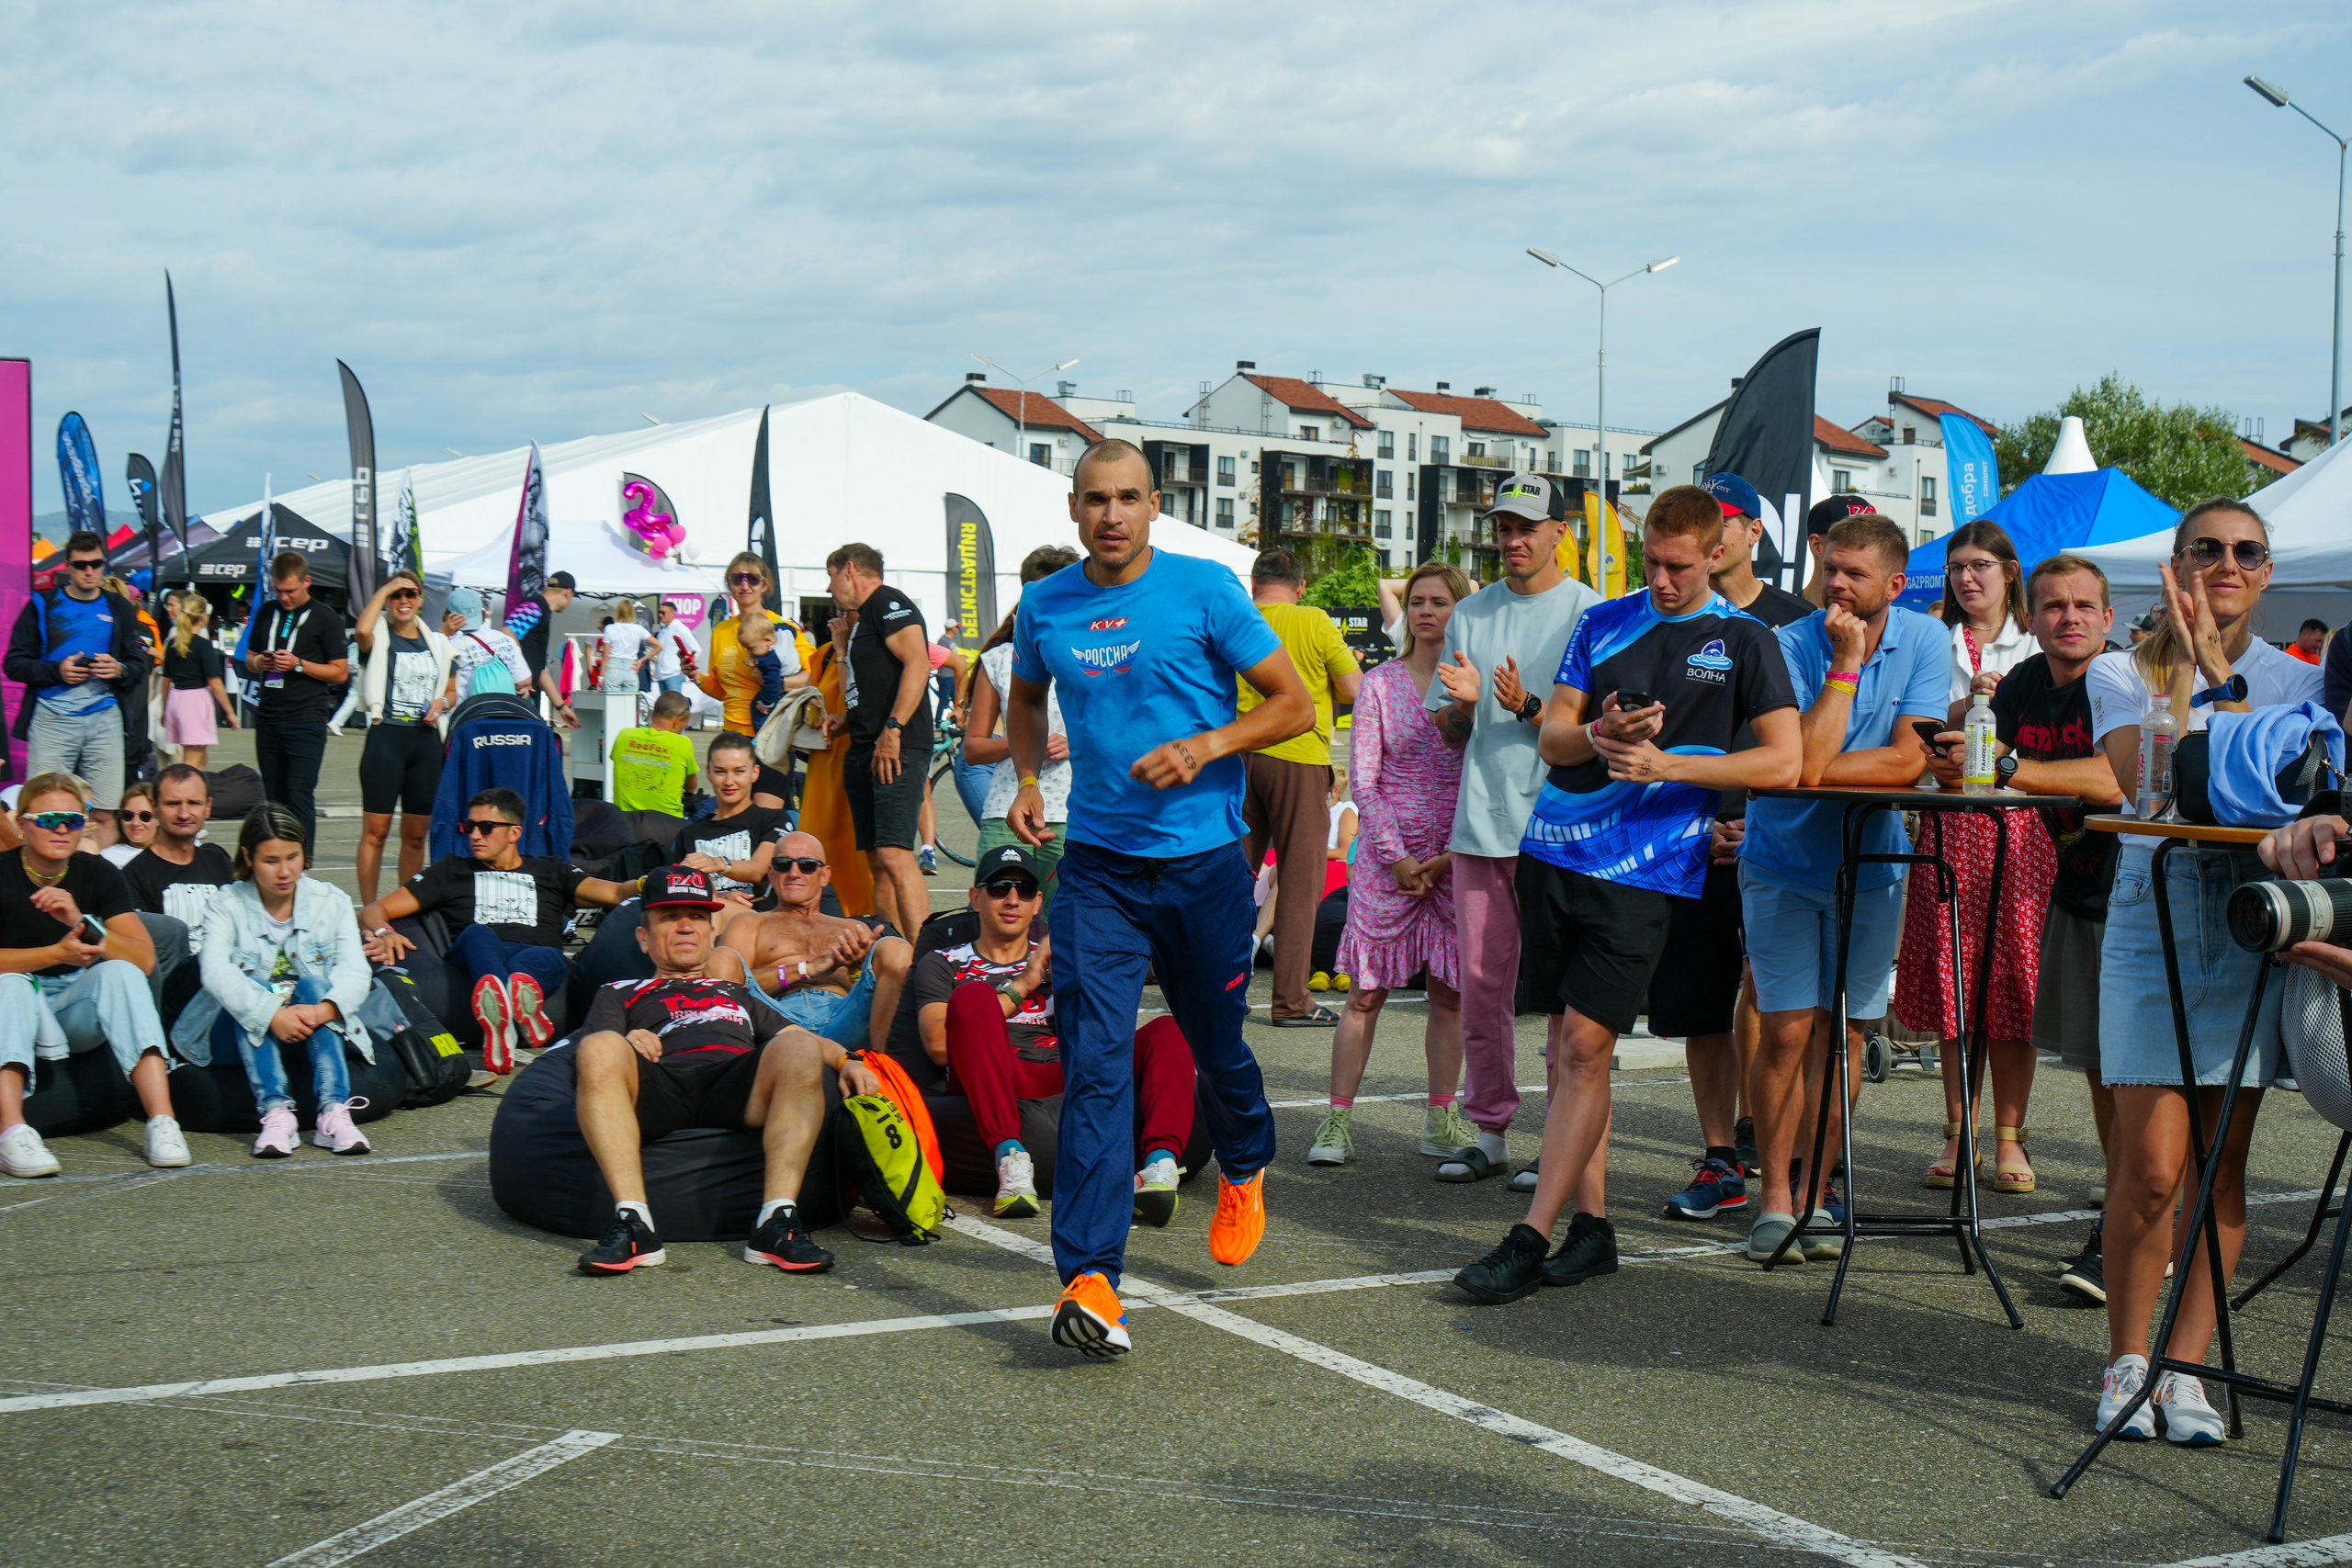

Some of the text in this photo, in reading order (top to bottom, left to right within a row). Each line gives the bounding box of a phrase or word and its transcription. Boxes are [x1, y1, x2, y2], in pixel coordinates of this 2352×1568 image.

[1521, 484, 1541, 496] STAR
[1962, 462, 1977, 516] добра
[275, 536, 329, 552] cep
[214, 564, 247, 578] cep
[666, 598, 702, 615] HOP
[1348, 617, 1368, 628] STAR
[1085, 645, 1128, 668] РОССИЯ
[1687, 668, 1725, 682] ВОЛНА
[472, 734, 532, 750] RUSSIA
